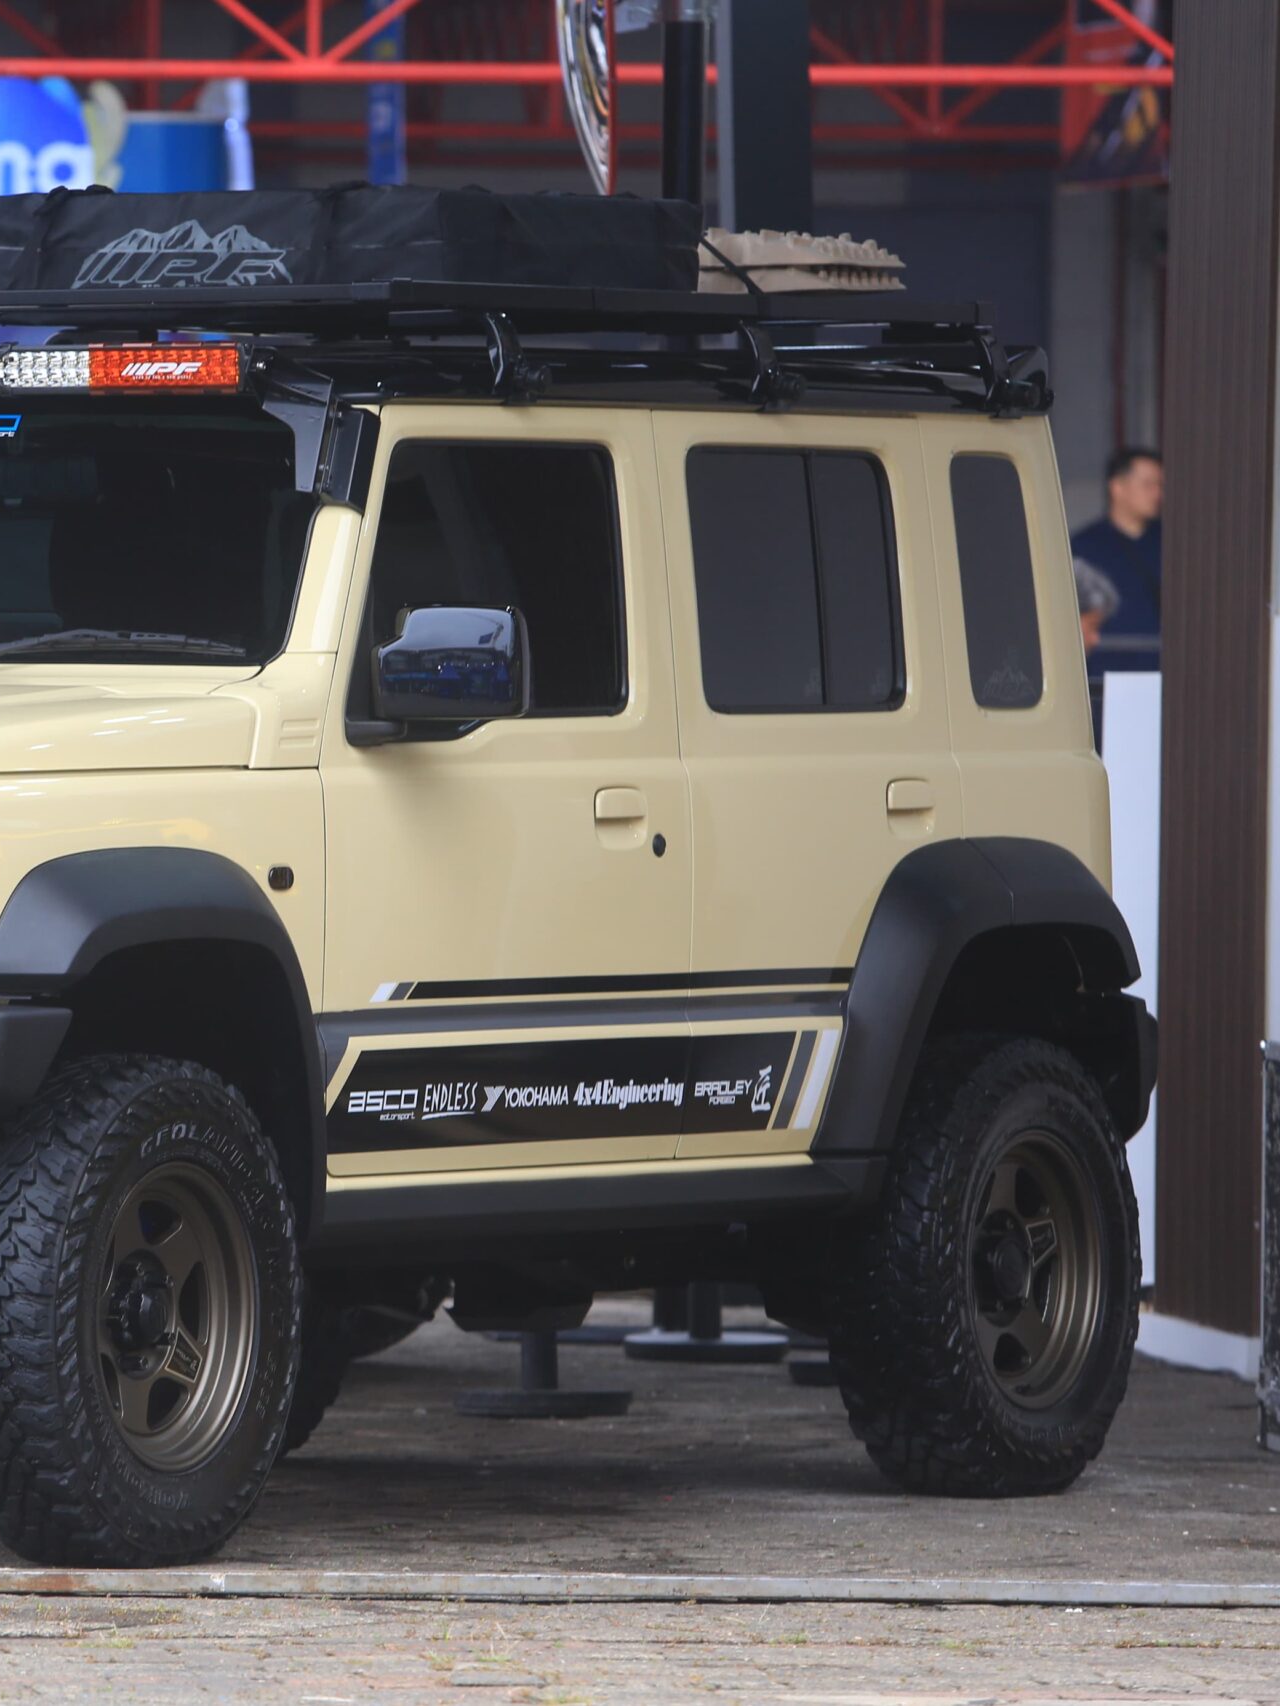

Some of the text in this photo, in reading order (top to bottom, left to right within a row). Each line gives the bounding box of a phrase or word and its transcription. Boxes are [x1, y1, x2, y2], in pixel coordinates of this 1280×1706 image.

[422, 1082, 478, 1112] ENDLESS
[505, 1085, 569, 1108] YOKOHAMA
[694, 1079, 753, 1097] BRADLEY
